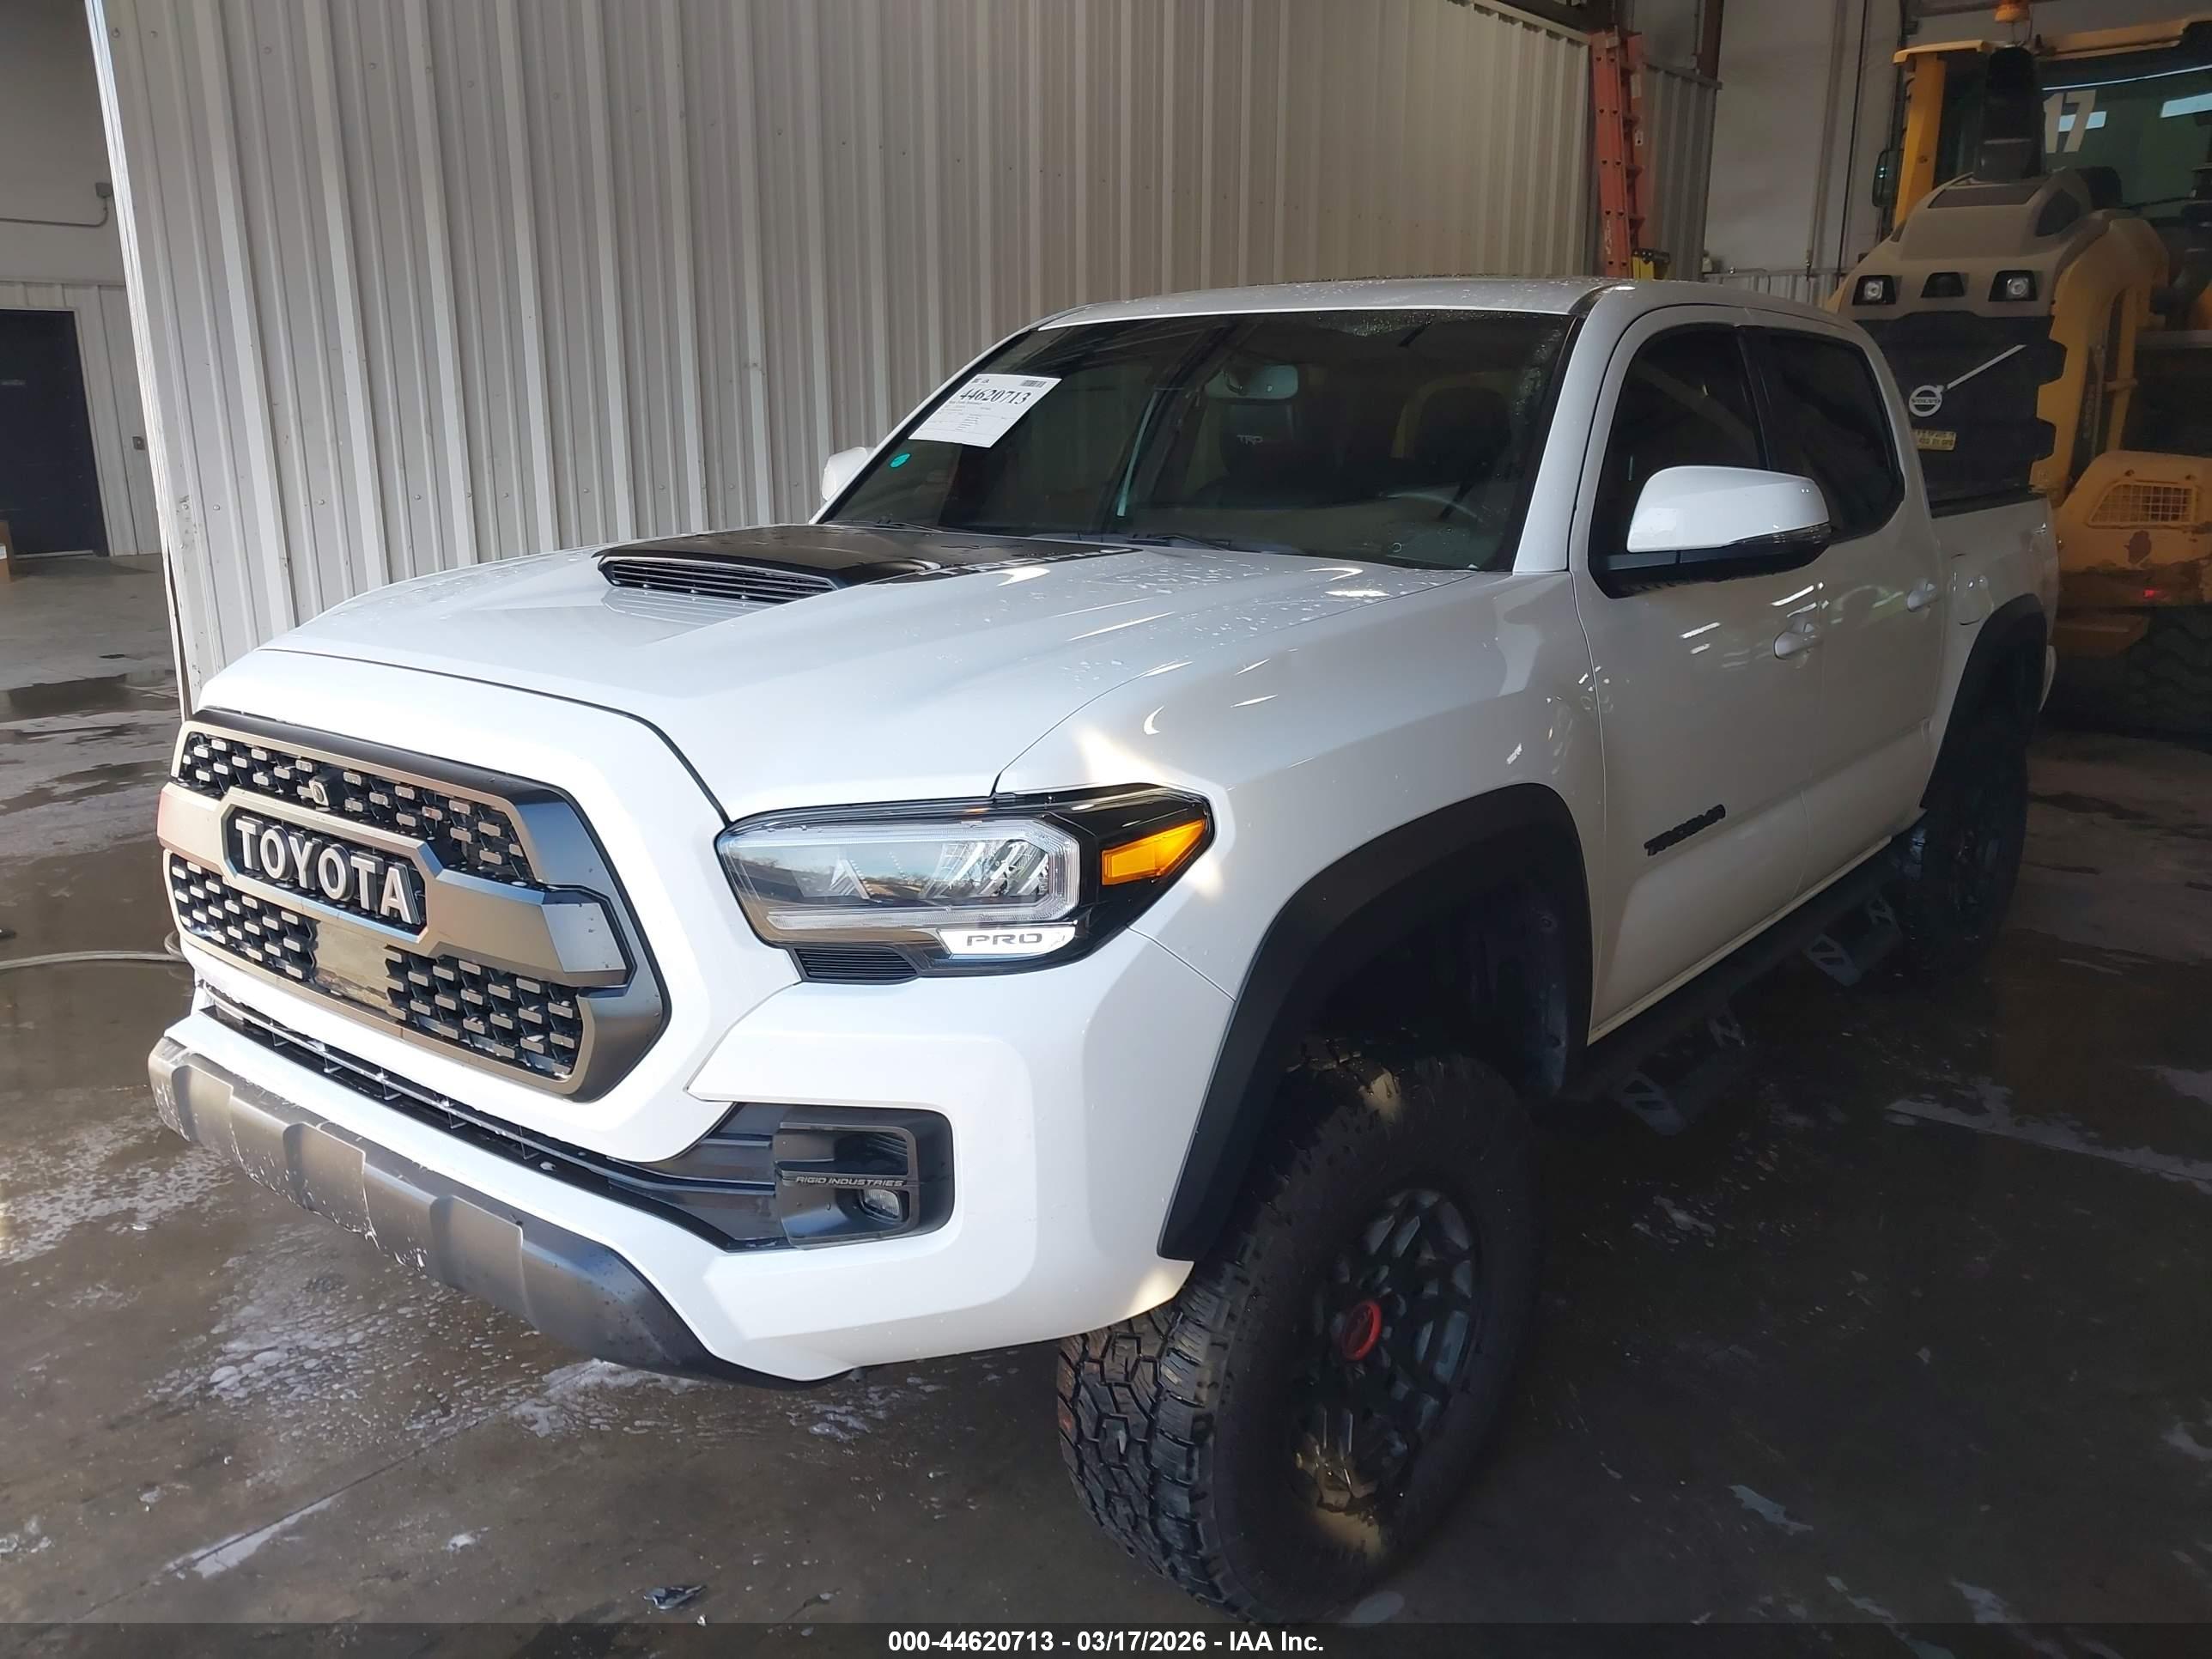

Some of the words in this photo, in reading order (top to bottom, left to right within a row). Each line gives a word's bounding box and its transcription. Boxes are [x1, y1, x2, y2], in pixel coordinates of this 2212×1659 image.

[2043, 89, 2097, 153] 17
[959, 388, 1032, 405] 44620713
[234, 816, 421, 925] TOYOTA
[966, 933, 1043, 947] PRO
[795, 1176, 827, 1184] RIGID
[827, 1177, 905, 1187] INDUSTRIES
